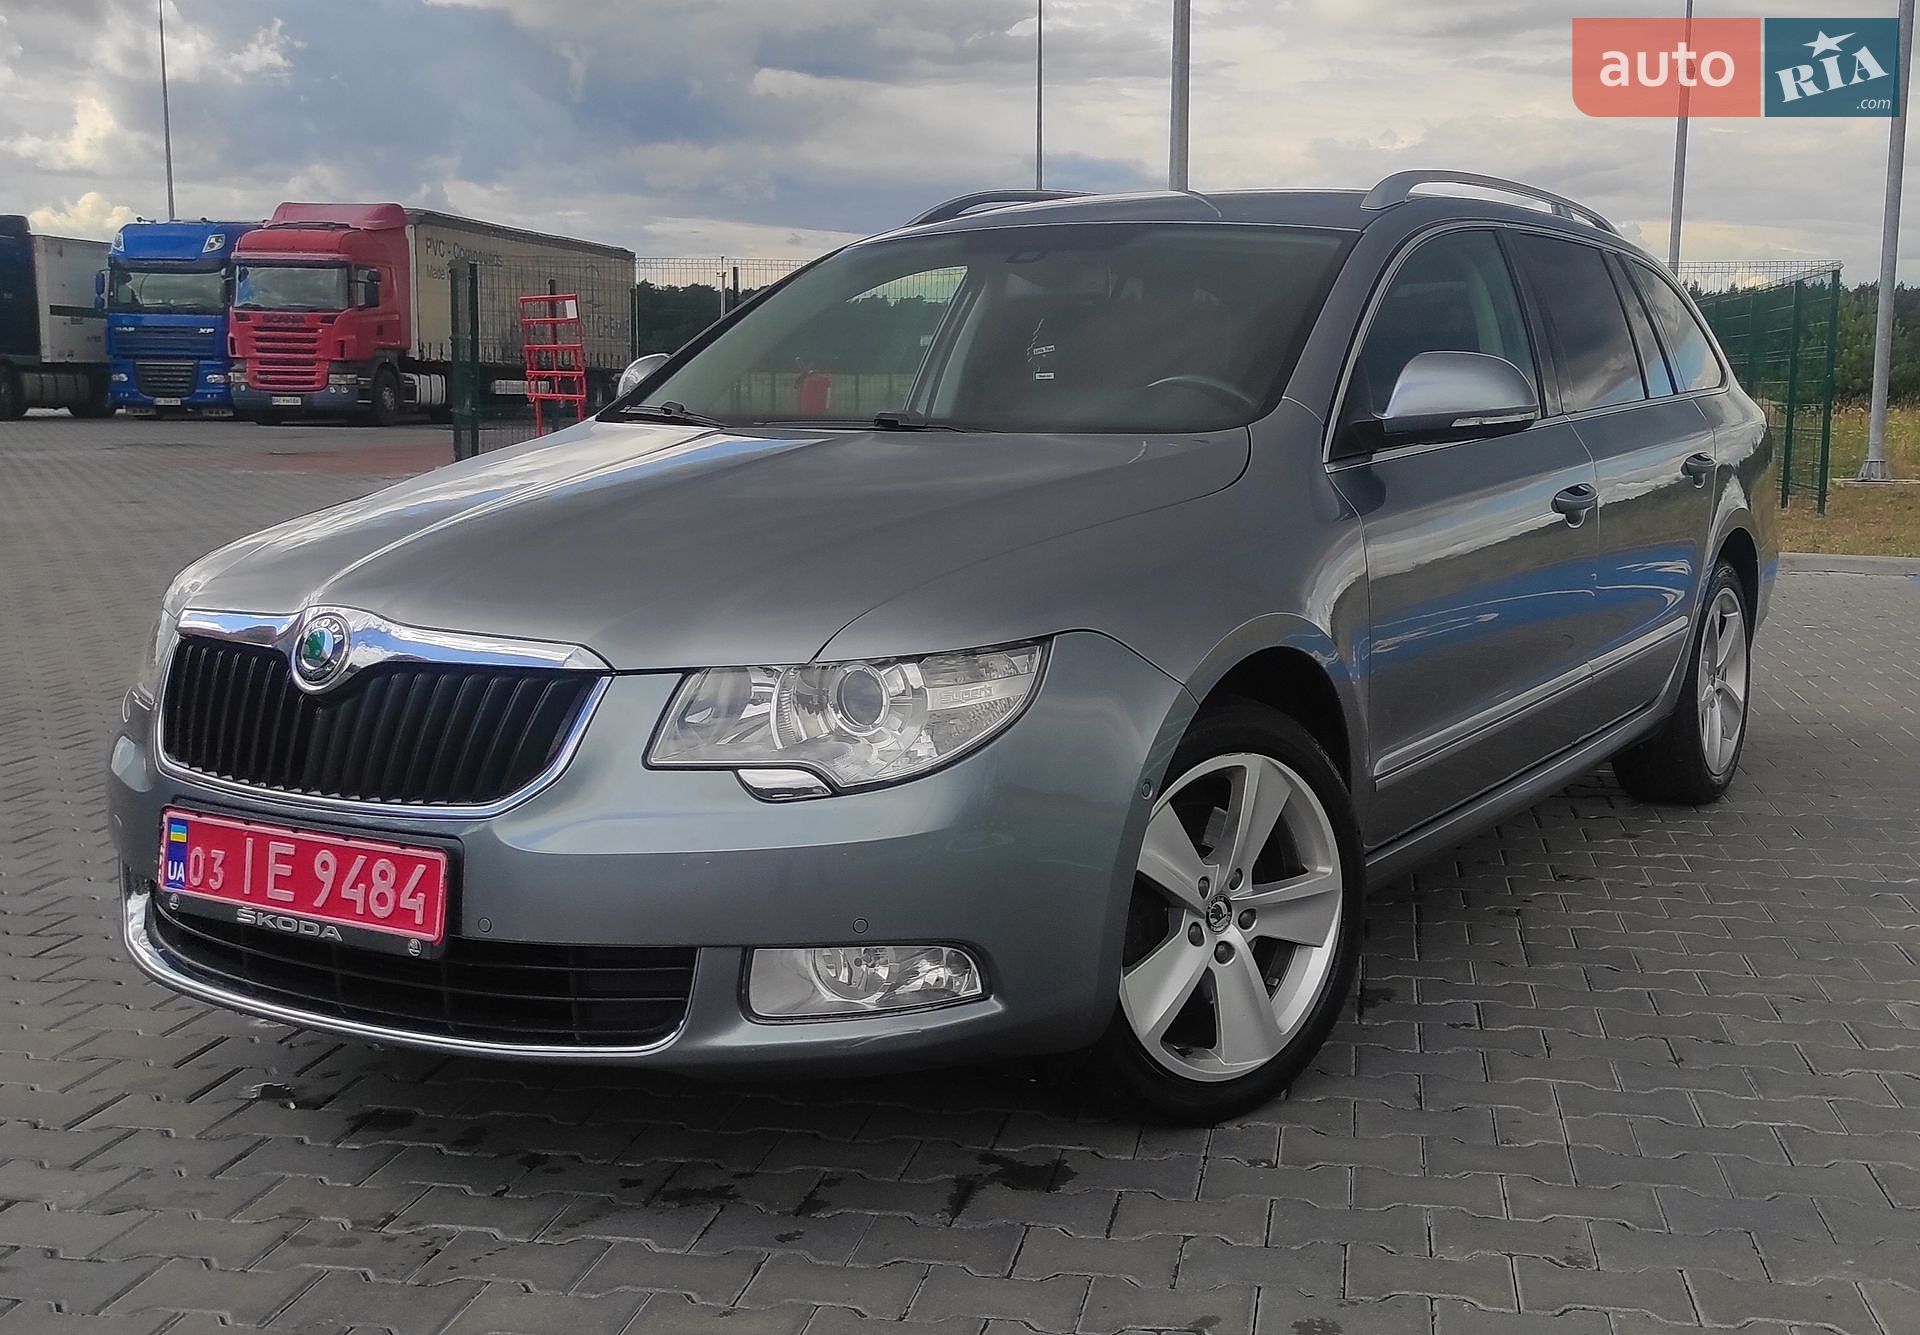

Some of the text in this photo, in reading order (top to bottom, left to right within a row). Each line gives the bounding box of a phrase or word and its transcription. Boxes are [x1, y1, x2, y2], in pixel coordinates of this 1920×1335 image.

[425, 237, 446, 258] PVC
[167, 860, 186, 884] UA
[188, 846, 226, 891] 03
[312, 849, 427, 926] 9484
[236, 906, 343, 943] ŠKODA
